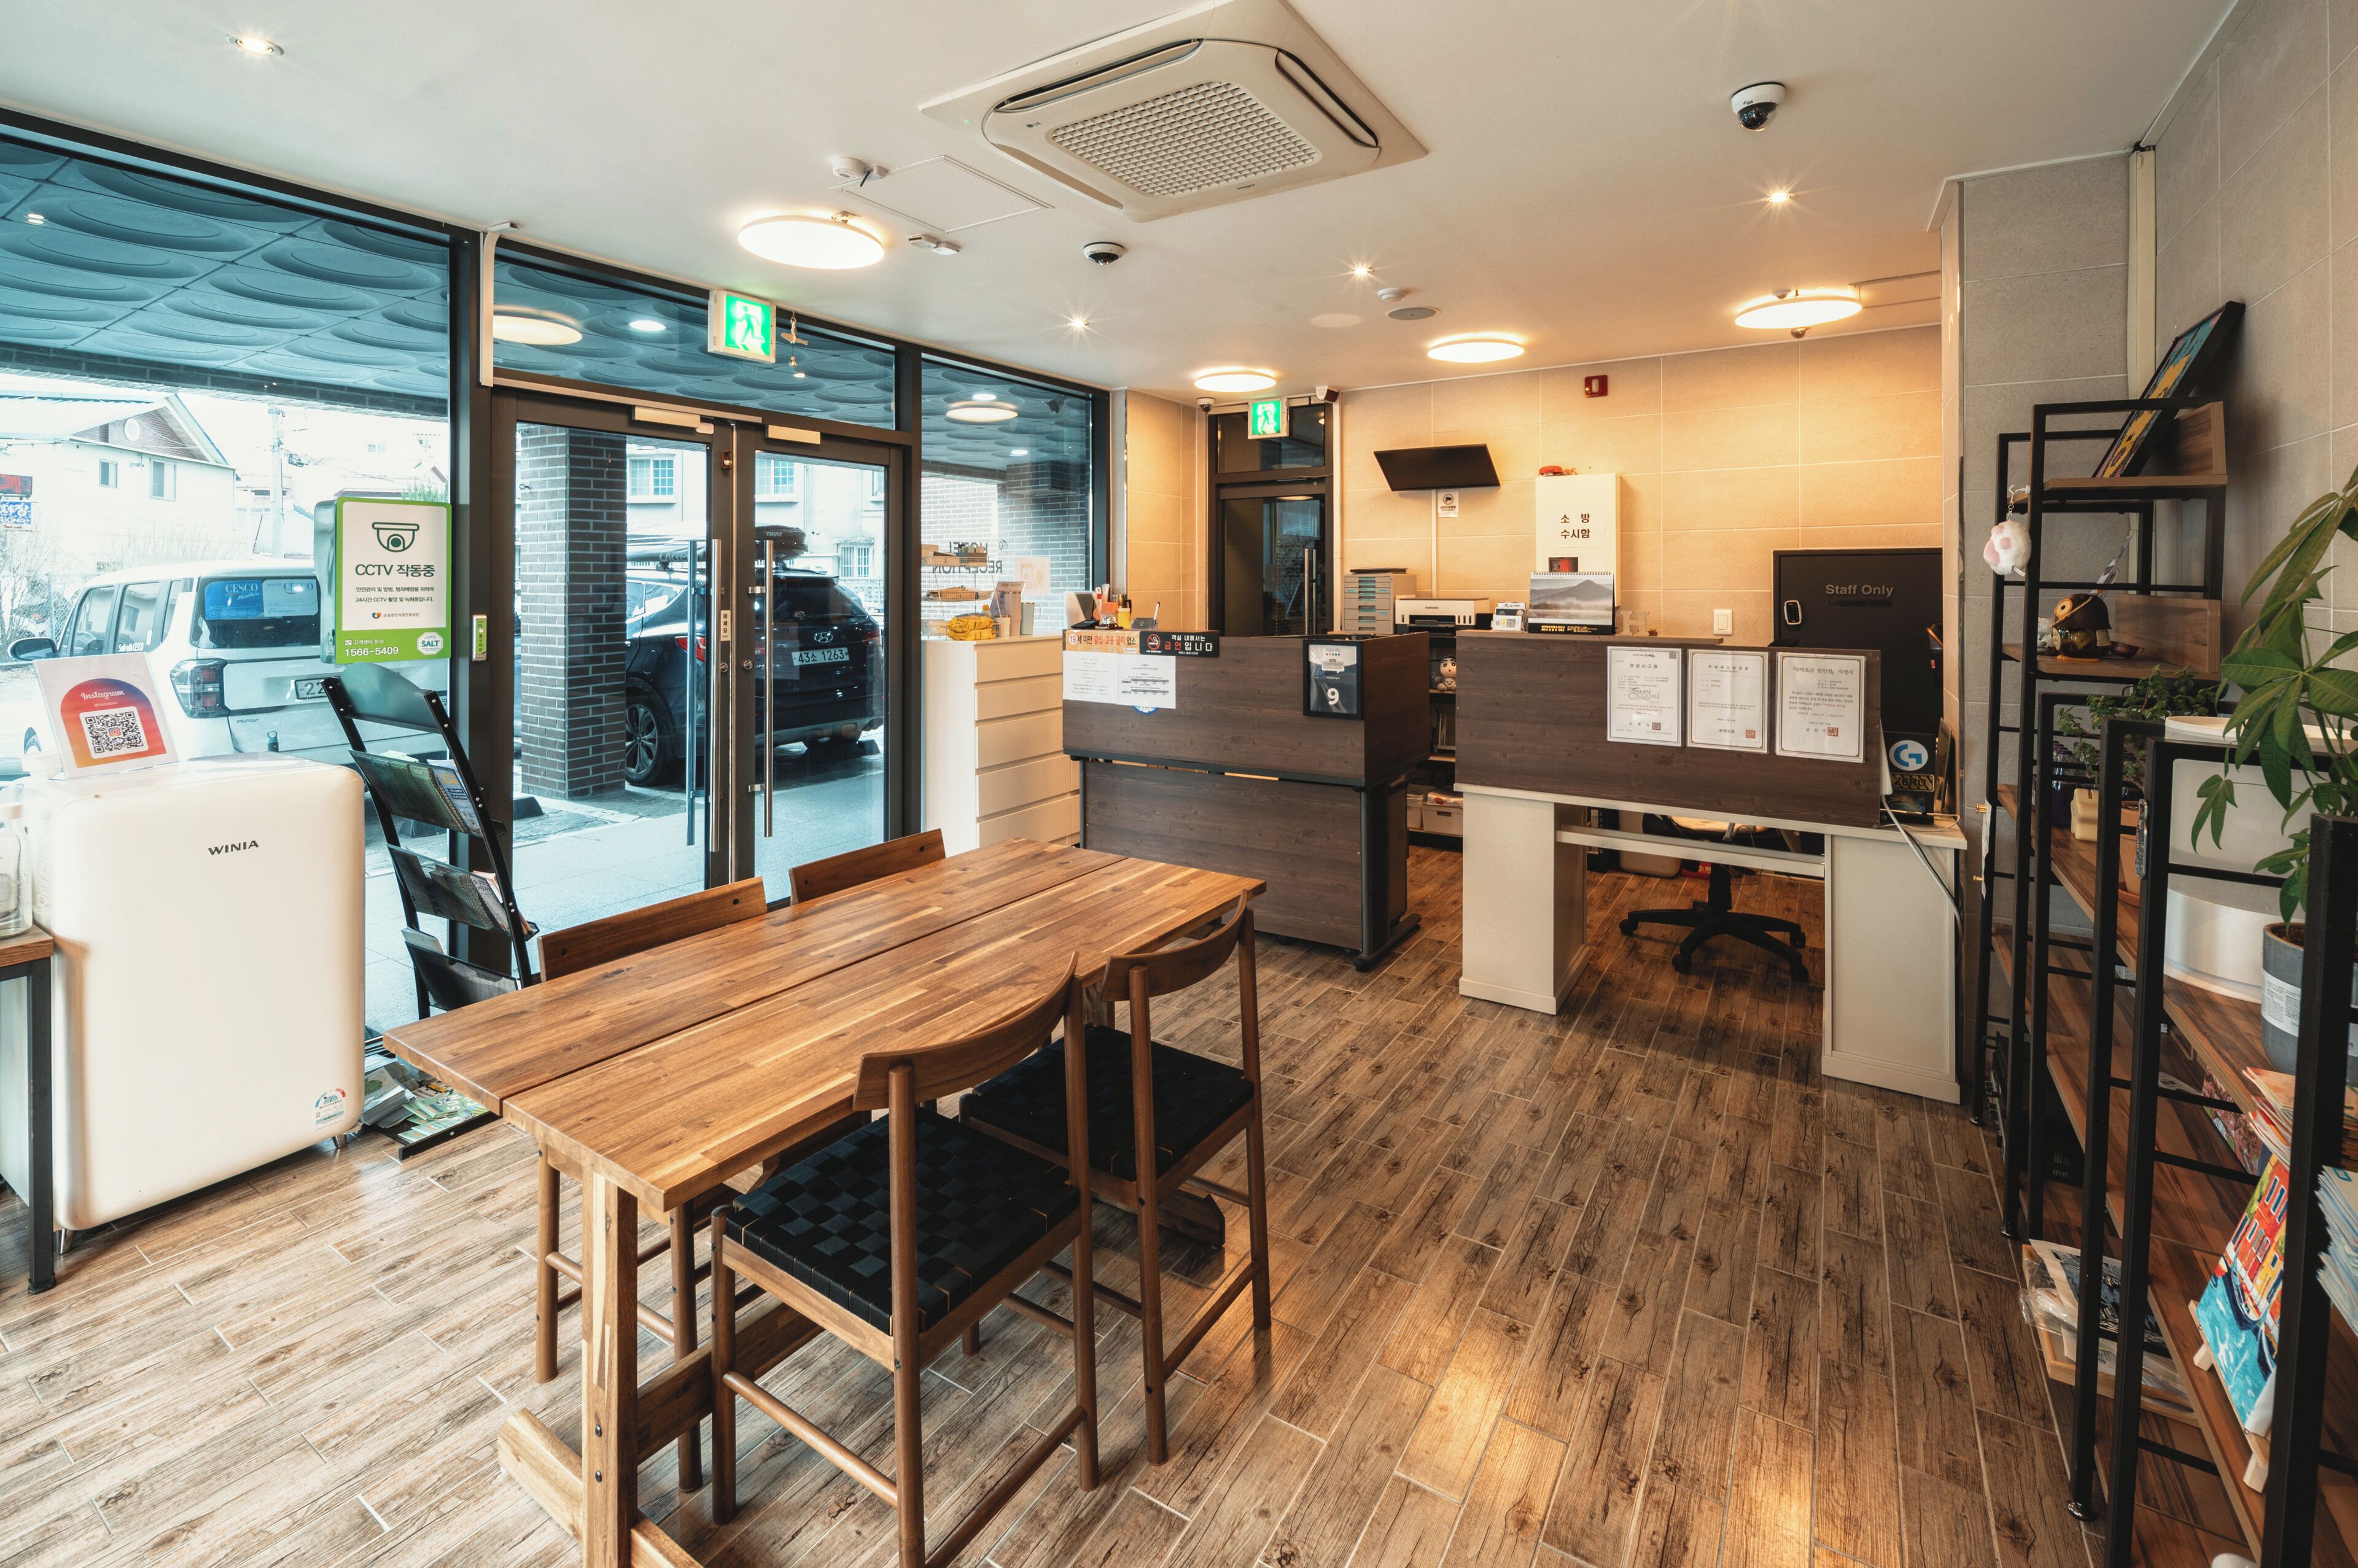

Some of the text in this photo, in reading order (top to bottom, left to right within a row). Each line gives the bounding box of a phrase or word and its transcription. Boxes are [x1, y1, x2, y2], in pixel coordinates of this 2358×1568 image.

[1560, 529, 1590, 539] 수시함
[355, 564, 435, 577] CCTV 작동중
[225, 583, 259, 592] CESCO
[1826, 584, 1894, 597] Staff Only
[1083, 635, 1092, 644] 미만
[1116, 636, 1126, 645] 금지
[1126, 636, 1137, 645] 업소
[345, 646, 399, 657] 1566-5409
[798, 650, 844, 663] 43소 1263
[80, 691, 125, 700] Instagram
[1327, 688, 1339, 705] 9
[208, 840, 259, 856] WINIA
